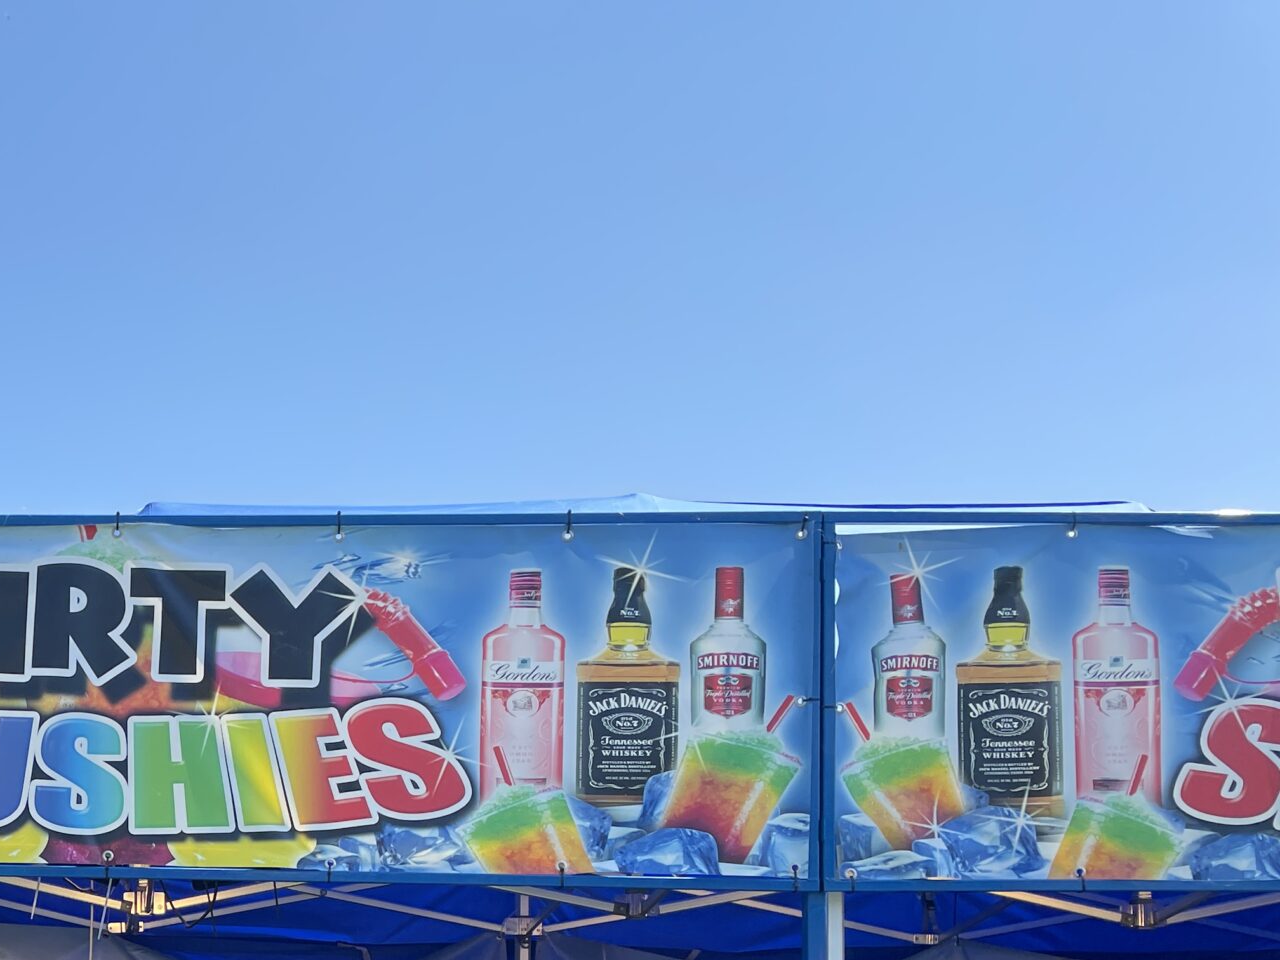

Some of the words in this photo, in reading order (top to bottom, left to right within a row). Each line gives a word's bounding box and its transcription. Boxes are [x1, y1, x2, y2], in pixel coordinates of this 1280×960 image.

[698, 653, 759, 669] SMIRNOFF
[881, 656, 939, 671] SMIRNOFF
[588, 697, 620, 717] JACK
[620, 692, 669, 718] DANIEL'S
[968, 698, 1000, 718] JACK
[1000, 694, 1051, 718] DANIEL'S
[600, 735, 653, 745] Tennessee
[981, 738, 1036, 748] Tennessee
[982, 751, 1035, 759] WHISKEY
